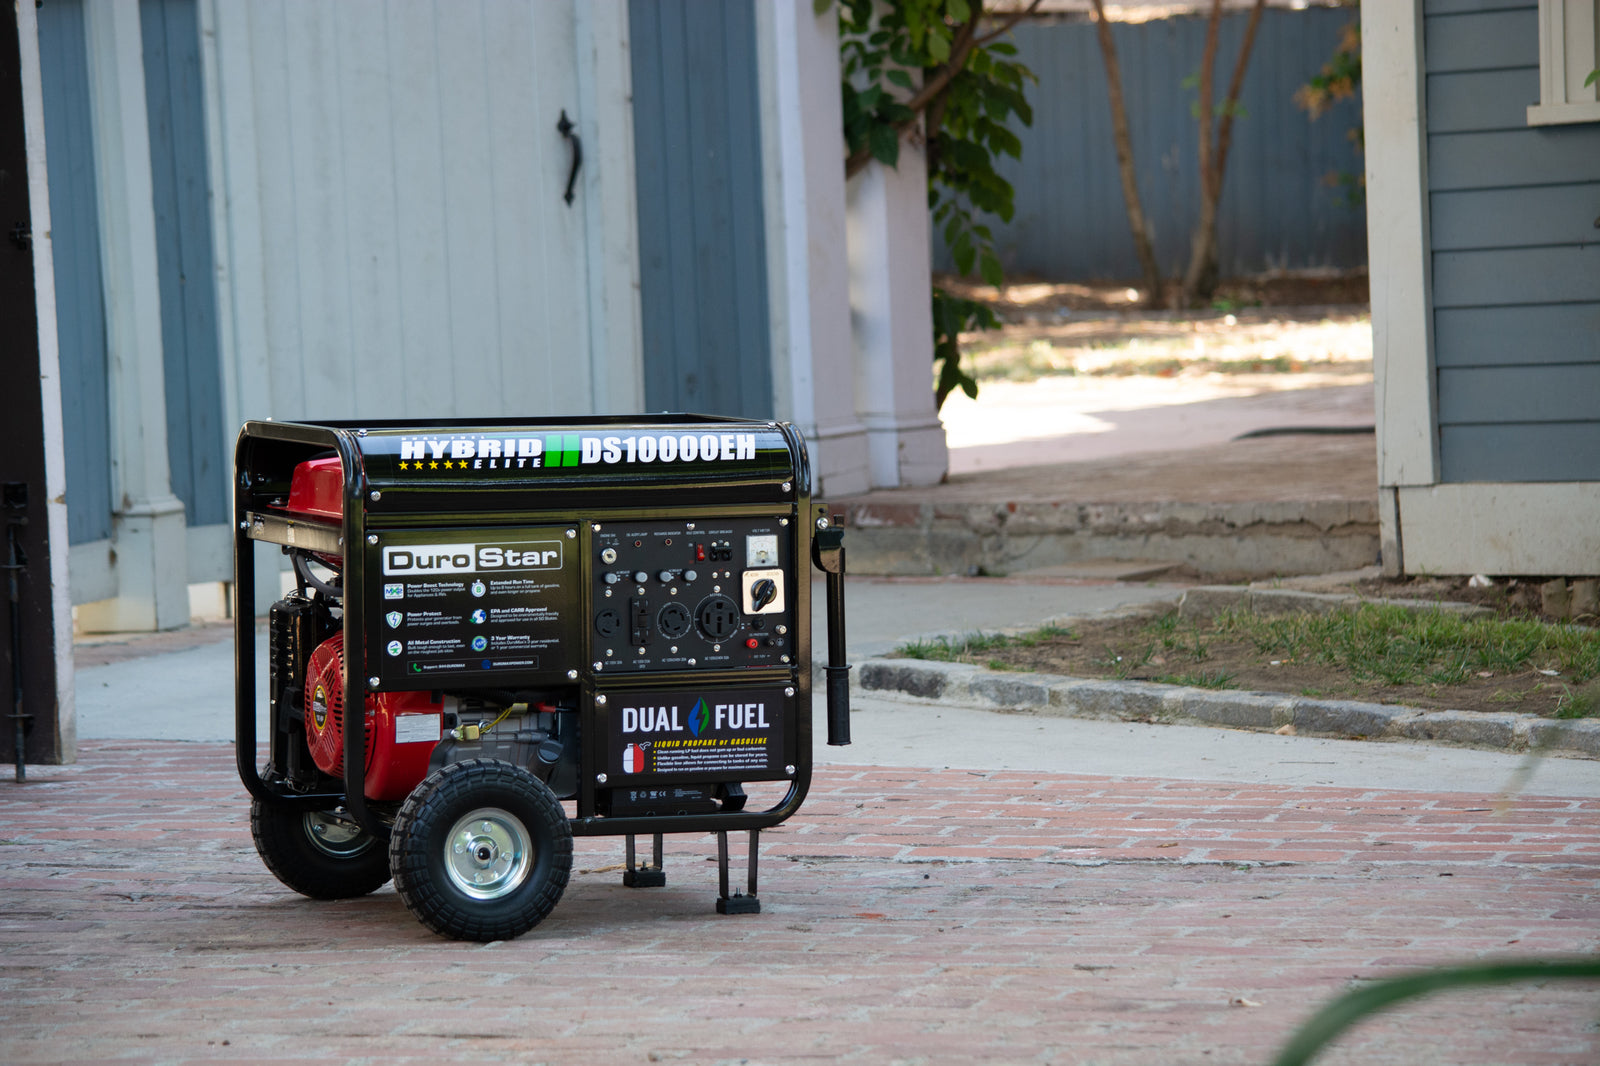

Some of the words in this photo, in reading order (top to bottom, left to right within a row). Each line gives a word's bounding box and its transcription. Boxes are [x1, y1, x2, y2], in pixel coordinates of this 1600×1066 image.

[400, 438, 542, 460] HYBRID
[582, 434, 756, 464] DS10000EH
[474, 458, 542, 470] ELITE
[388, 550, 470, 570] Duro
[478, 548, 558, 568] Star
[622, 706, 684, 733] DUAL
[715, 703, 770, 730] FUEL
[654, 740, 680, 748] LIQUID
[682, 739, 717, 748] PROPANE
[730, 737, 768, 746] GASOLINE
